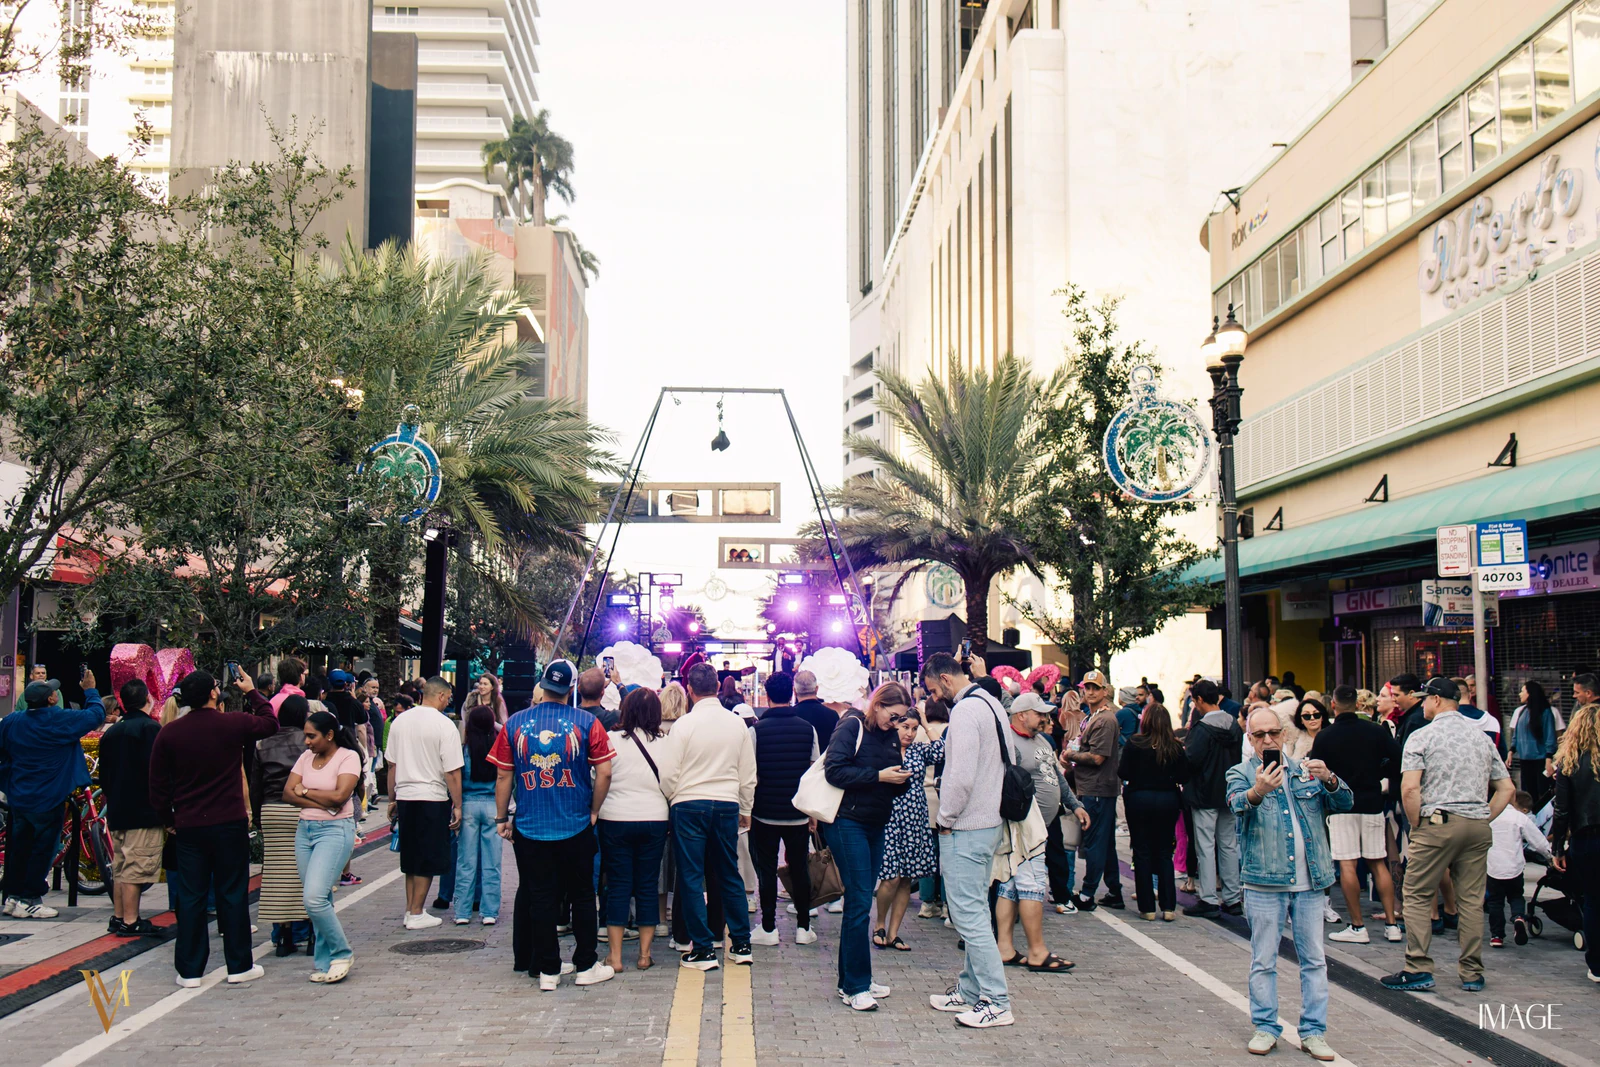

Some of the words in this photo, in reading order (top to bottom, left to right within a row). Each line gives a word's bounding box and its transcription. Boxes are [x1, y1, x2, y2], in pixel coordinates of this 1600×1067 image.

[1448, 529, 1458, 537] NO
[1440, 536, 1467, 546] STOPPING
[1449, 544, 1458, 552] OR
[1440, 552, 1468, 561] STANDING
[1529, 550, 1588, 581] sonite
[1481, 571, 1523, 583] 40703
[1552, 576, 1590, 589] DEALER
[1346, 589, 1384, 612] GNC
[521, 768, 576, 791] USA
